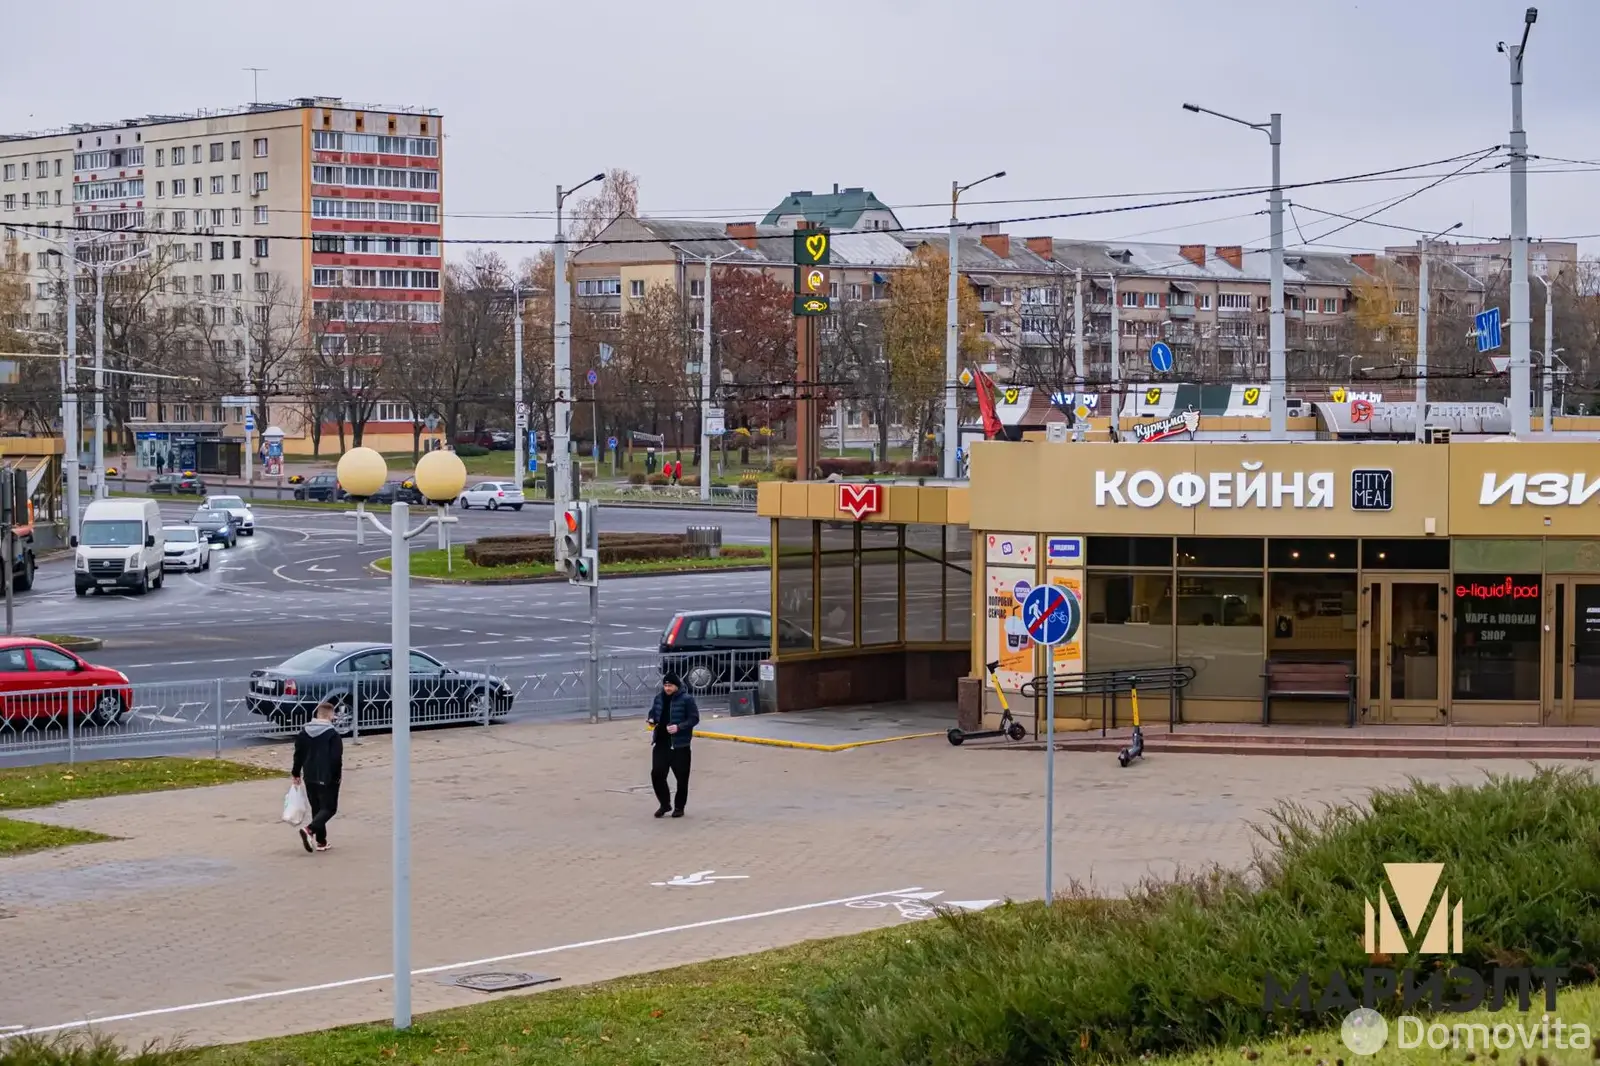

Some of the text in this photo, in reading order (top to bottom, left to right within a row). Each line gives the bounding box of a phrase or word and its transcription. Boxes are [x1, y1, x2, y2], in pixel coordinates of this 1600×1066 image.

[1133, 414, 1185, 438] Куркума
[1095, 461, 1334, 508] КОФЕЙНЯ
[1354, 473, 1390, 490] FITTY
[1354, 489, 1390, 506] MEAL
[1456, 583, 1538, 599] e-liquid pod
[1465, 613, 1489, 624] VAPE
[1481, 630, 1506, 641] SHOP
